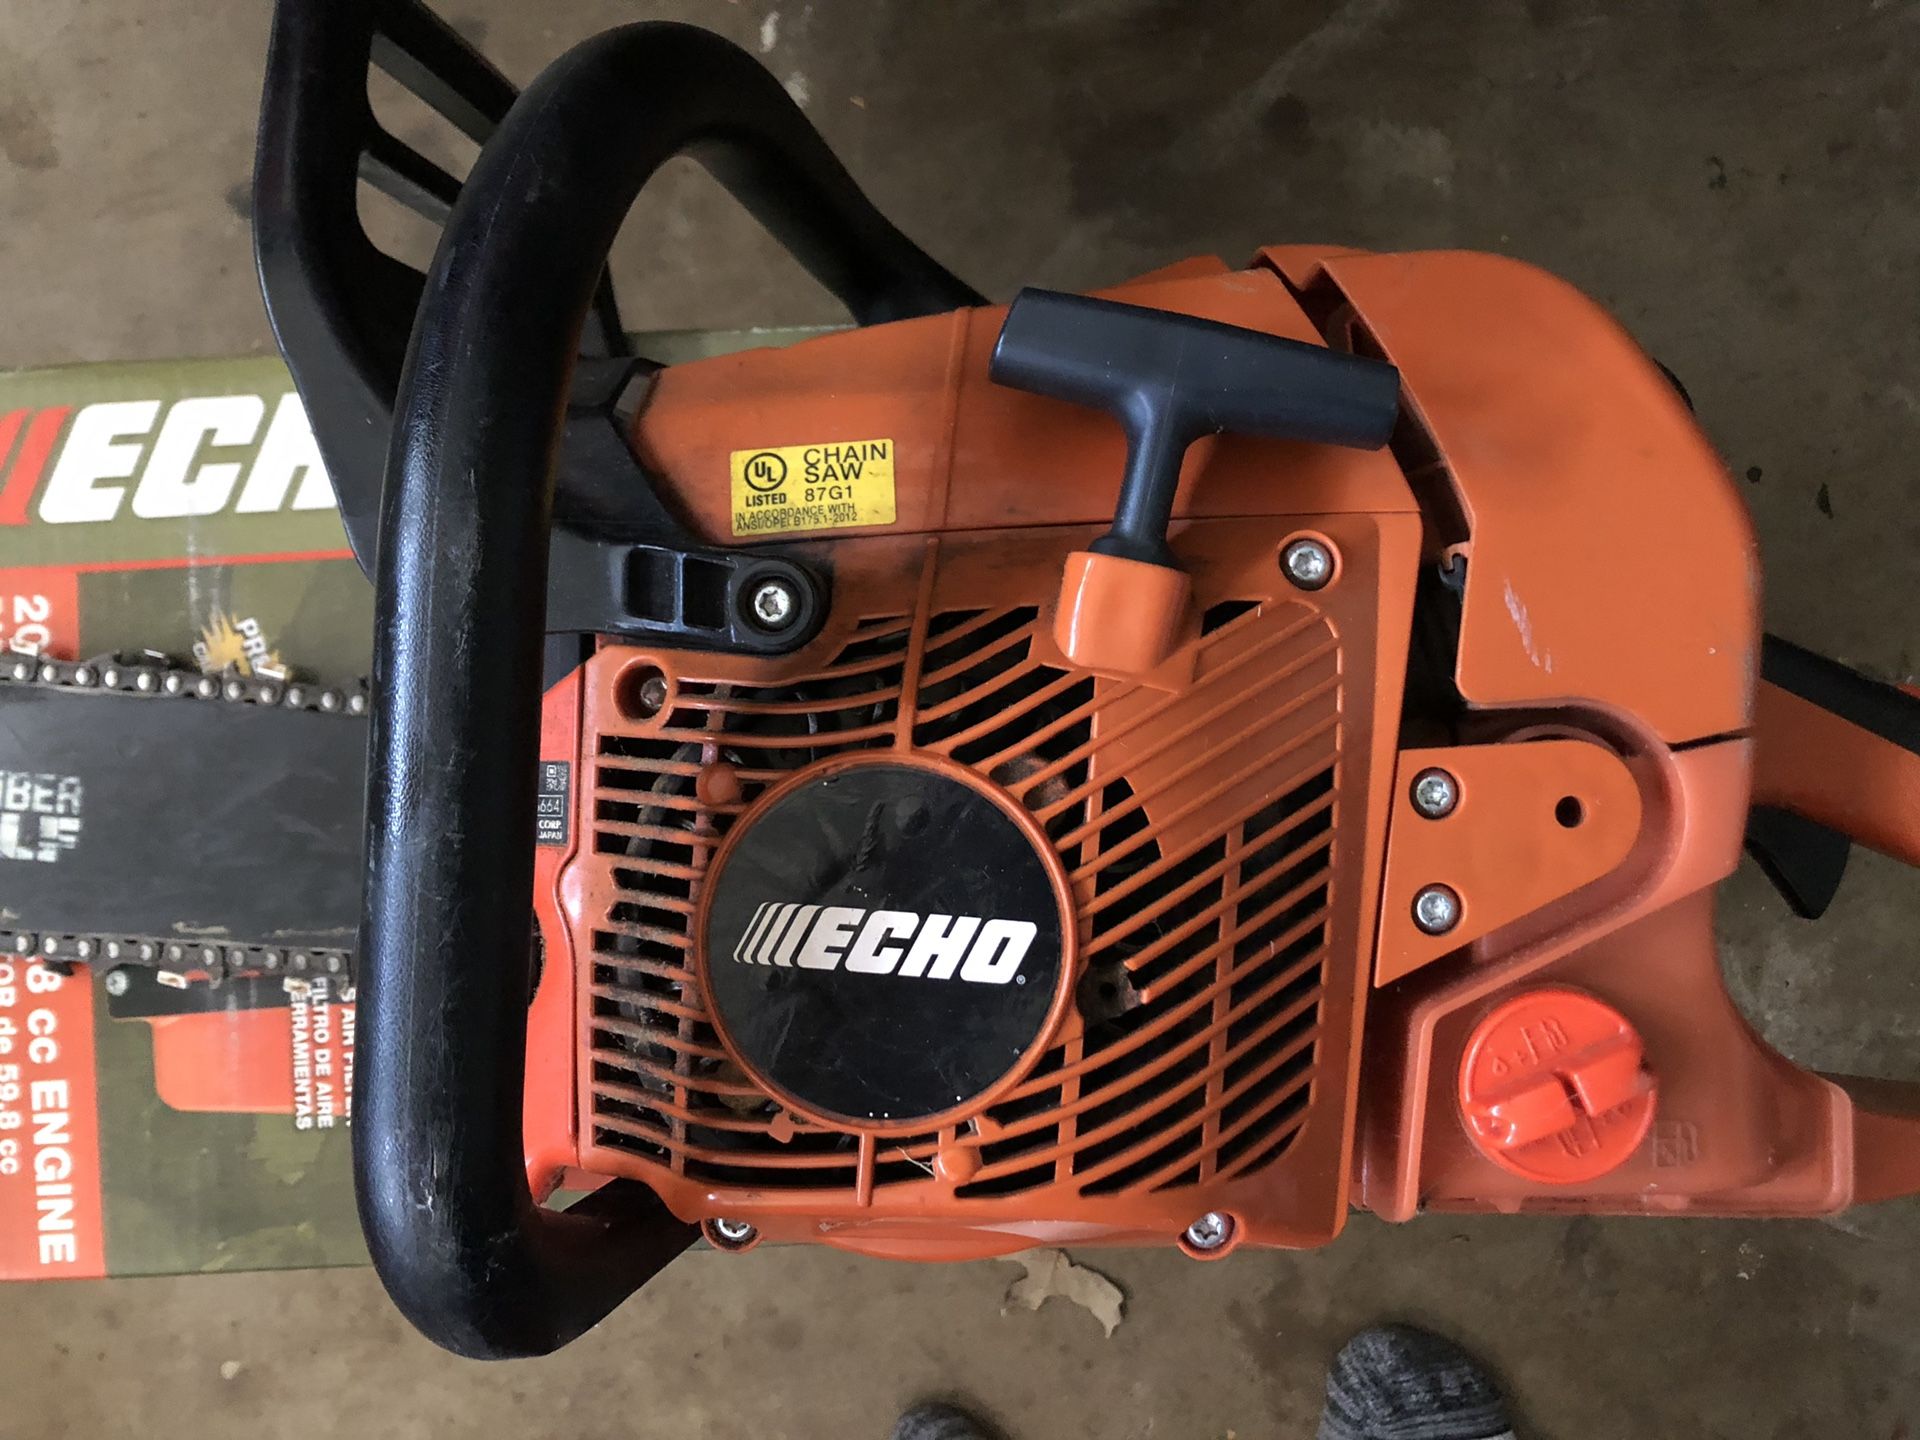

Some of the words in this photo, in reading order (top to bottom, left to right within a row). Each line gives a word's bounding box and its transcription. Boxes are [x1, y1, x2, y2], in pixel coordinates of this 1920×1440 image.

[38, 392, 338, 524] ECH
[803, 443, 886, 465] CHAIN
[754, 461, 777, 483] UL
[804, 462, 863, 484] SAW
[745, 492, 787, 507] LISTED
[804, 485, 853, 502] 87G1
[735, 512, 746, 522] IN
[750, 505, 824, 521] ACCORDANCE
[828, 503, 855, 514] WITH
[794, 511, 858, 527] B175.1-2012
[0, 771, 82, 815] BER
[538, 820, 562, 829] CORP.
[538, 831, 562, 840] JAPAN
[796, 905, 1038, 985] ECHO
[311, 976, 330, 1044] FILTRO
[27, 1008, 57, 1064] cc
[290, 988, 313, 1131] ERRAMIENTAS
[314, 1048, 332, 1077] DE
[0, 1063, 20, 1130] 59.8
[316, 1081, 334, 1129] AIRE
[0, 1138, 19, 1175] cc
[30, 1079, 77, 1265] ENGINE
